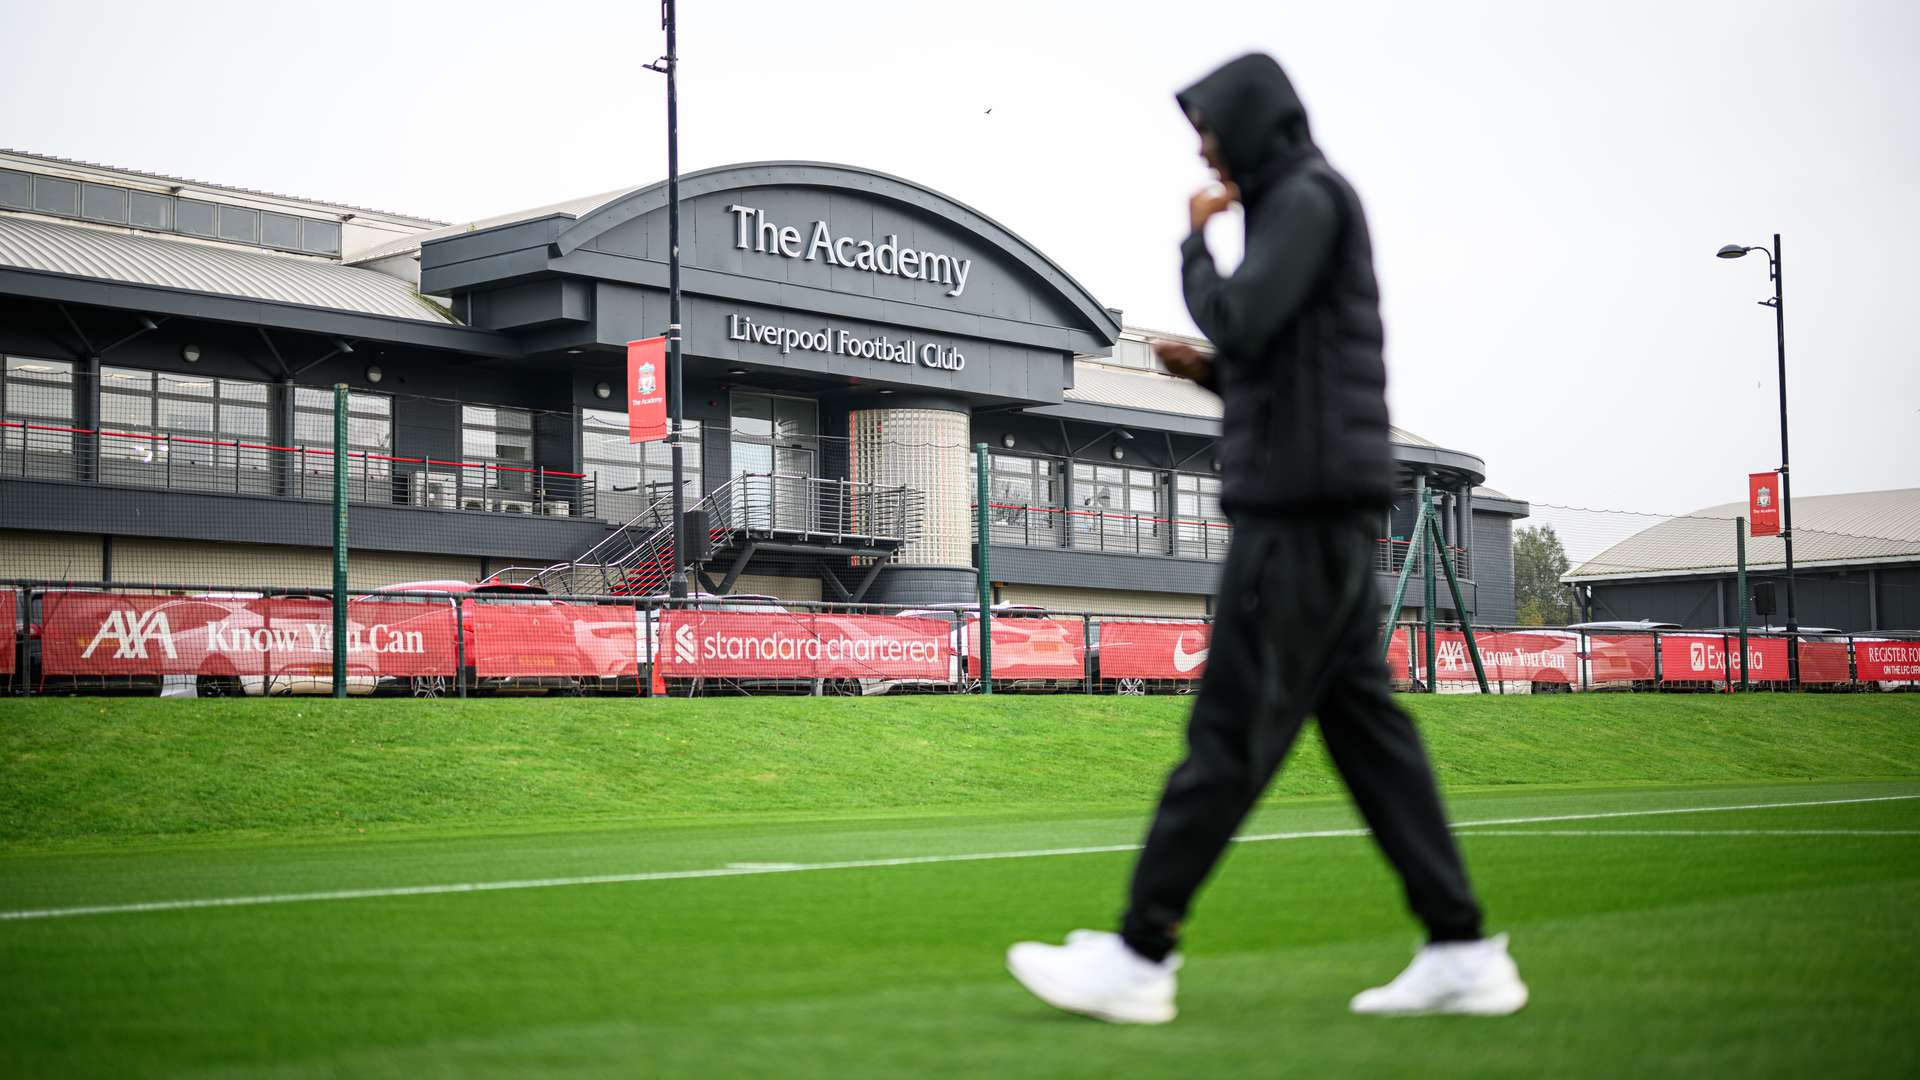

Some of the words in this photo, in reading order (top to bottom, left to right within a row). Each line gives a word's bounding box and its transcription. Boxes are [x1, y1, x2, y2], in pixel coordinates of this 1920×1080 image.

[730, 203, 802, 258] The
[805, 220, 972, 297] Academy
[729, 313, 832, 354] Liverpool
[836, 329, 916, 365] Football
[920, 343, 966, 371] Club
[81, 610, 178, 660] AXA
[206, 621, 299, 653] Know
[305, 623, 362, 653] Yu
[369, 623, 425, 654] Can
[703, 631, 821, 661] standard
[827, 634, 939, 663] chartered
[1434, 640, 1468, 672] AXA
[1514, 647, 1540, 668] You
[1540, 649, 1565, 669] Can
[1869, 647, 1908, 662] REGISTER
[1908, 647, 1920, 662] FO
[1901, 665, 1910, 674] LFC
